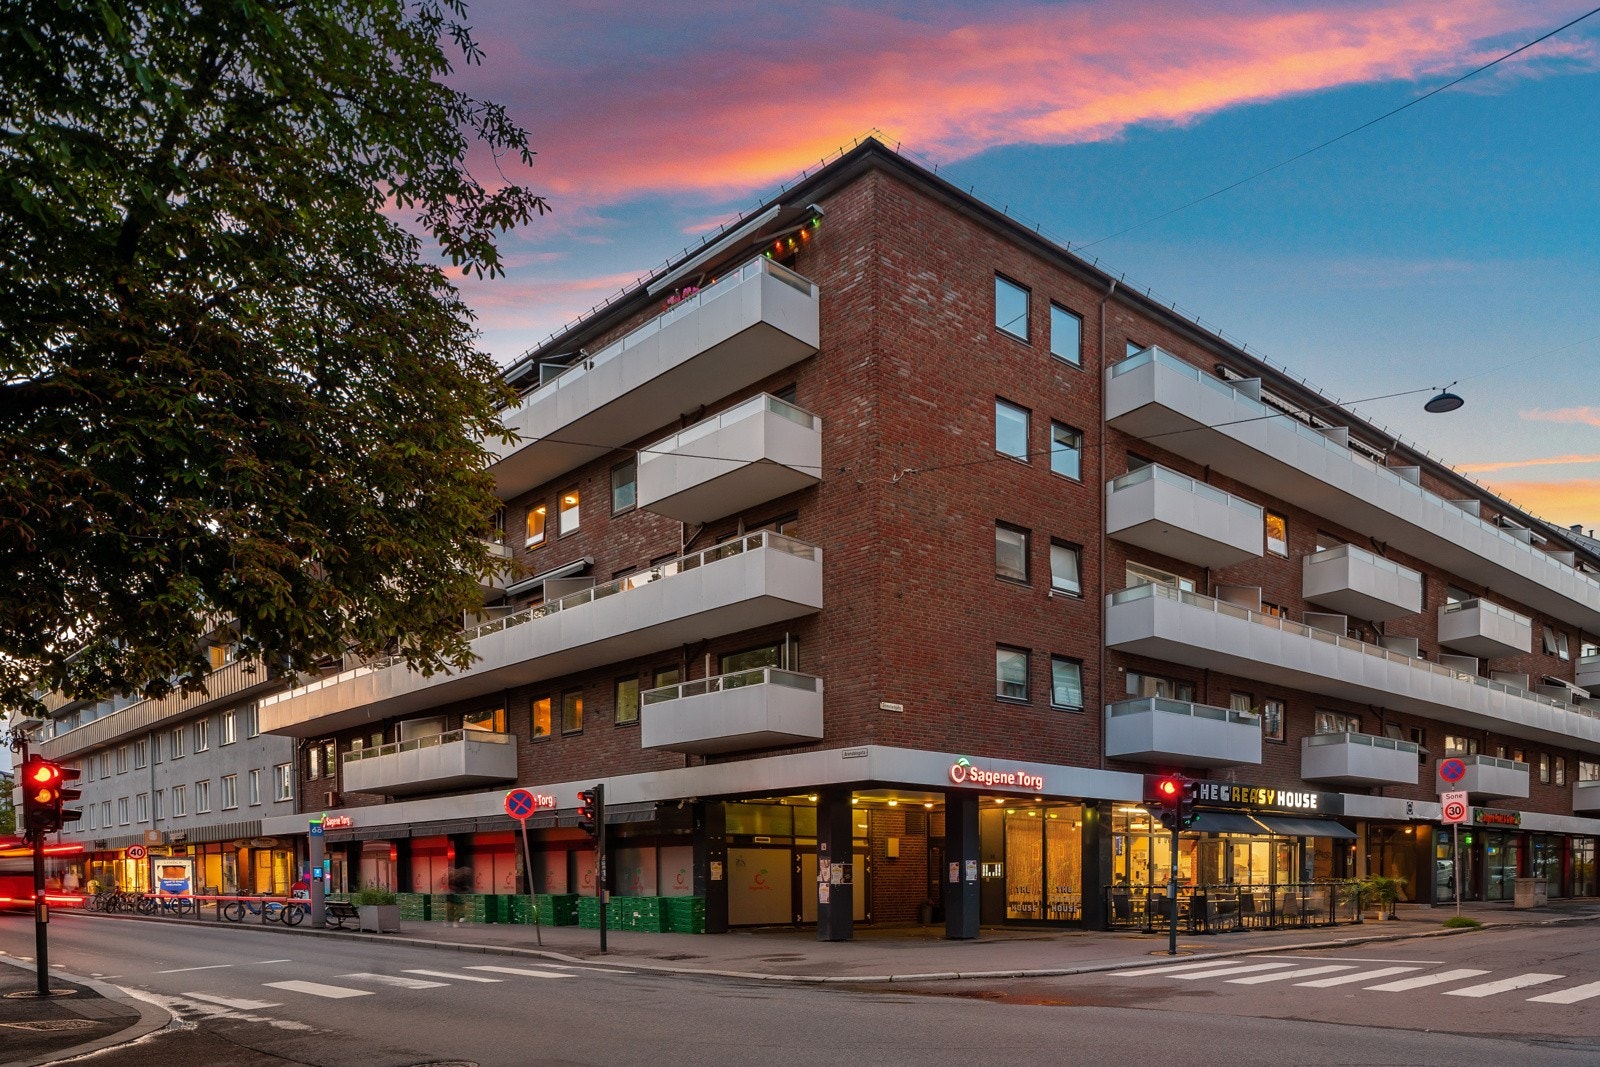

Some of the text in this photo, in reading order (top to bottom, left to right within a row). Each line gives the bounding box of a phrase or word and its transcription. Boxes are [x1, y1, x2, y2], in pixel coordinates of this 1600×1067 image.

[970, 766, 1043, 790] Sagene Torg
[538, 794, 554, 808] Torg
[1220, 785, 1275, 805] GREASY
[1277, 790, 1318, 809] HOUSE
[1448, 806, 1462, 816] 30
[130, 848, 143, 857] 40
[1011, 904, 1038, 912] HOUSE
[1051, 904, 1079, 912] HOUSE
